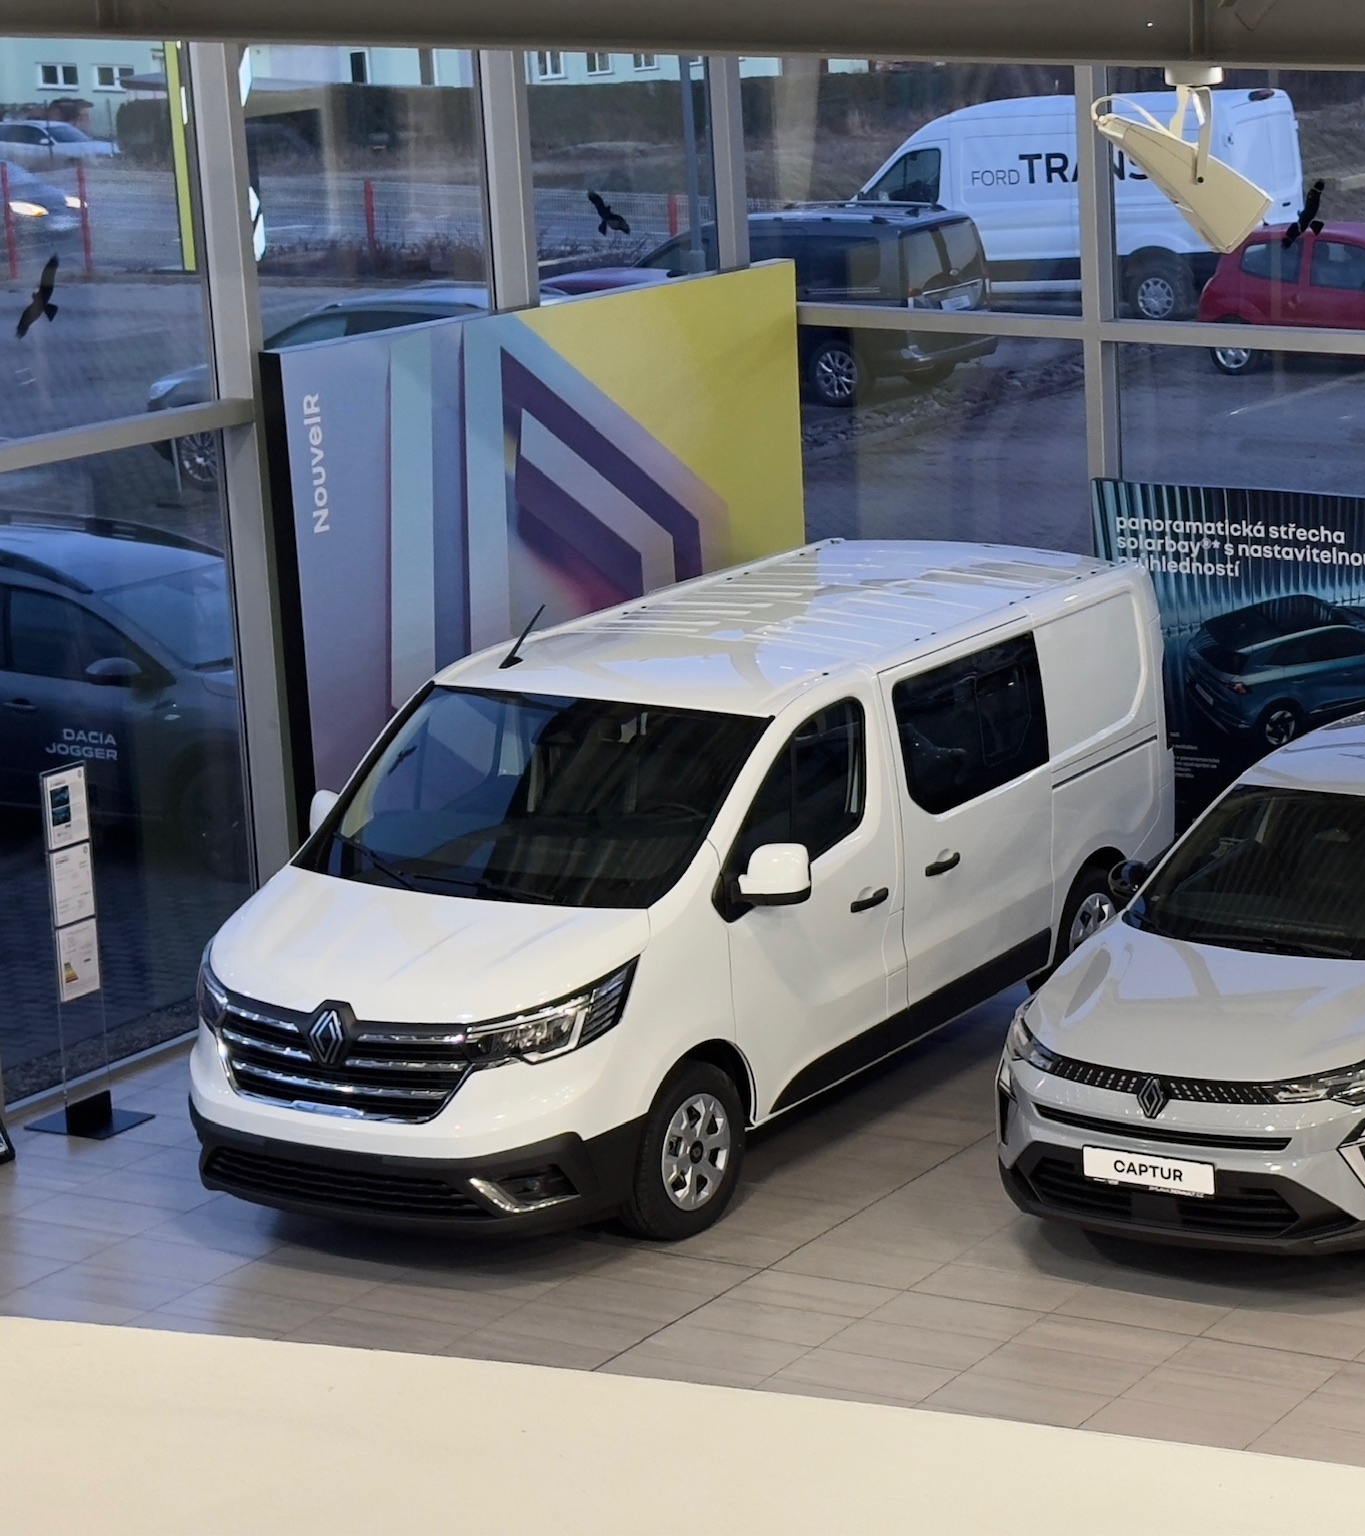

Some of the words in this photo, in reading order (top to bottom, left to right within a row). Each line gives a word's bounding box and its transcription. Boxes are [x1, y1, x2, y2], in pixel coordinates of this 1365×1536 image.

[971, 169, 1020, 187] FORD
[1116, 516, 1266, 539] panoramatická
[1268, 524, 1345, 545] střecha
[1224, 542, 1235, 556] s
[62, 728, 117, 746] DACIA
[45, 742, 118, 761] JOGGER
[1113, 1159, 1183, 1182] CAPTUR
